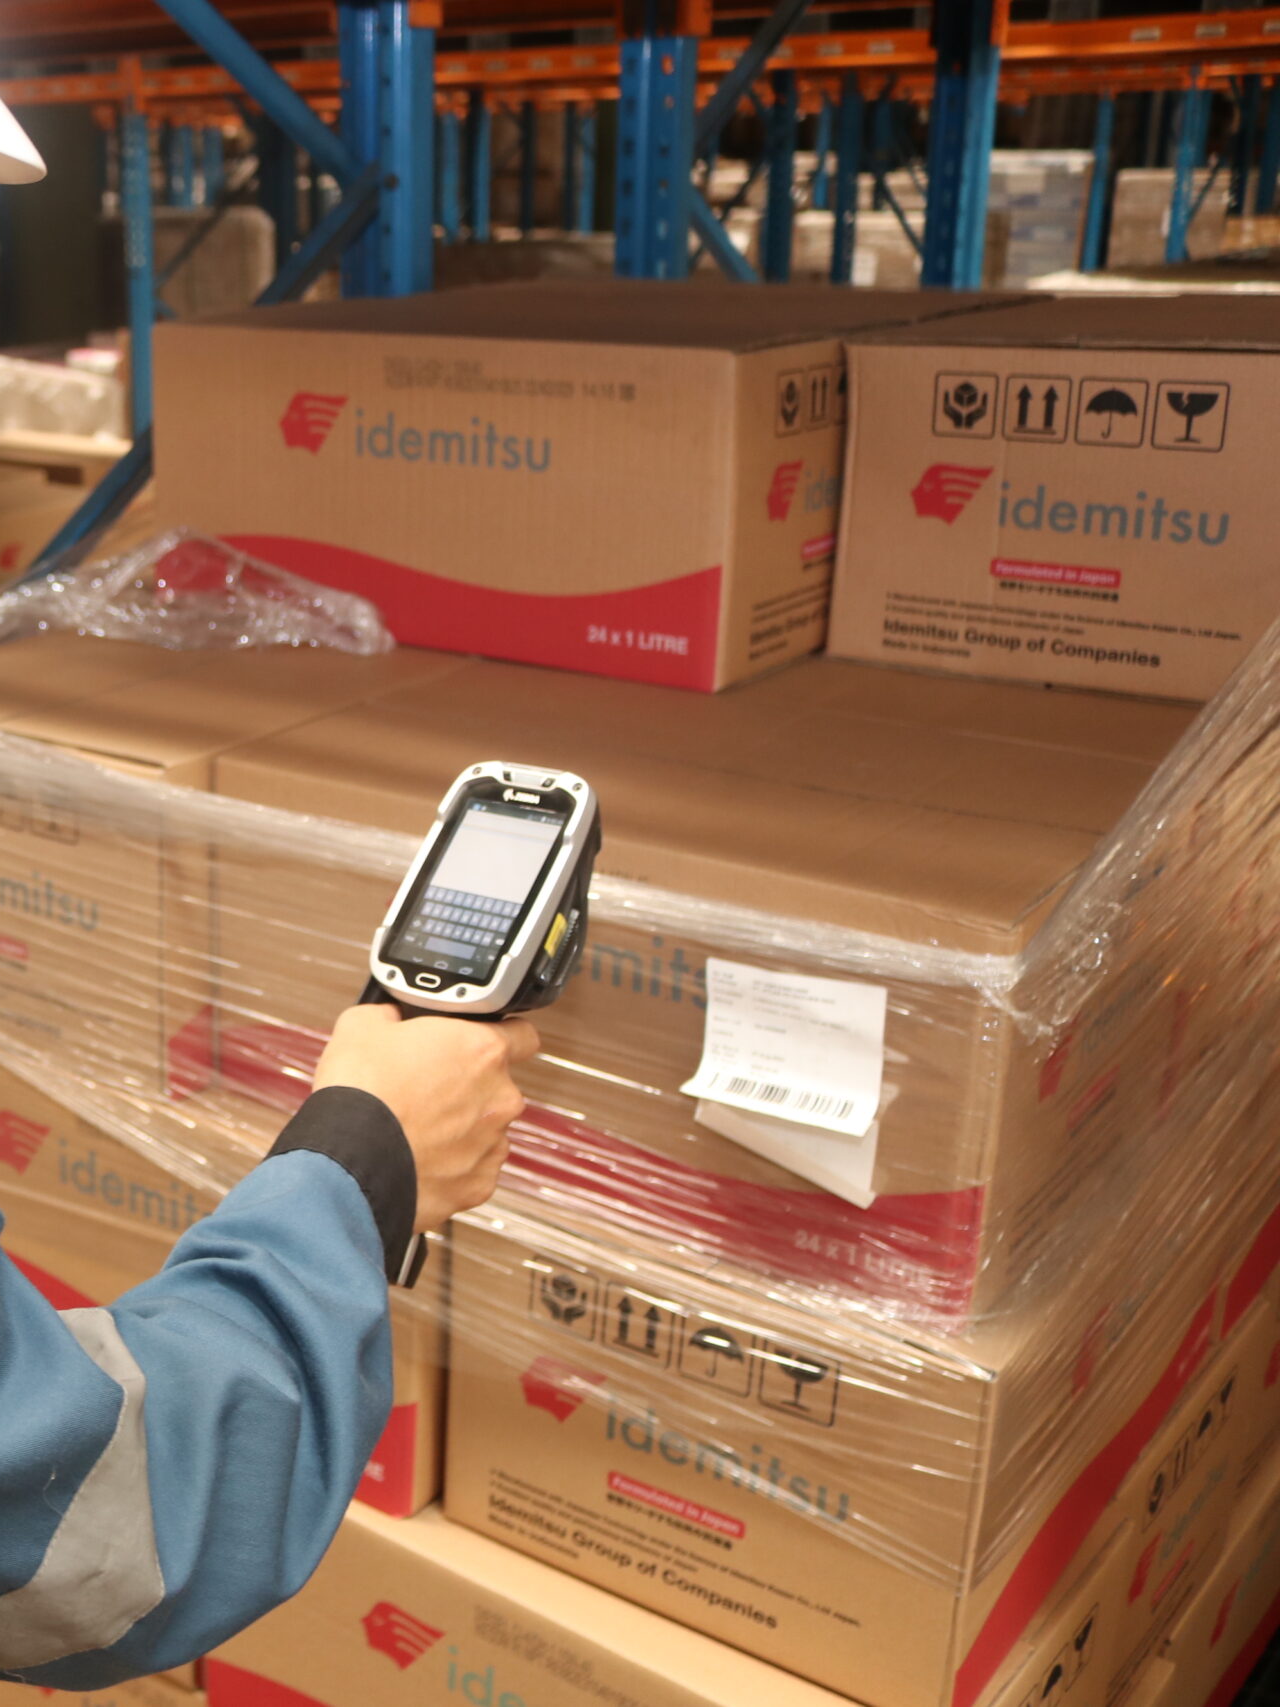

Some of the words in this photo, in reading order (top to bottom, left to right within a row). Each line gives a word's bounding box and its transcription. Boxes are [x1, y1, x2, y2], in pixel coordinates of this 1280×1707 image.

[355, 408, 552, 473] idemitsu
[997, 482, 1231, 548] idemitsu
[587, 623, 608, 644] 24
[625, 629, 634, 649] 1
[638, 631, 689, 656] LITRE
[883, 618, 959, 642] Idemitsu
[964, 626, 1022, 652] Group
[1026, 636, 1046, 653] of
[1050, 637, 1161, 669] Companies
[58, 1136, 214, 1229] idemit
[605, 1393, 850, 1523] idemitsu
[488, 1493, 567, 1539] Idemitsu
[571, 1530, 632, 1568] Group
[637, 1560, 658, 1578] of
[661, 1567, 780, 1630] Companies
